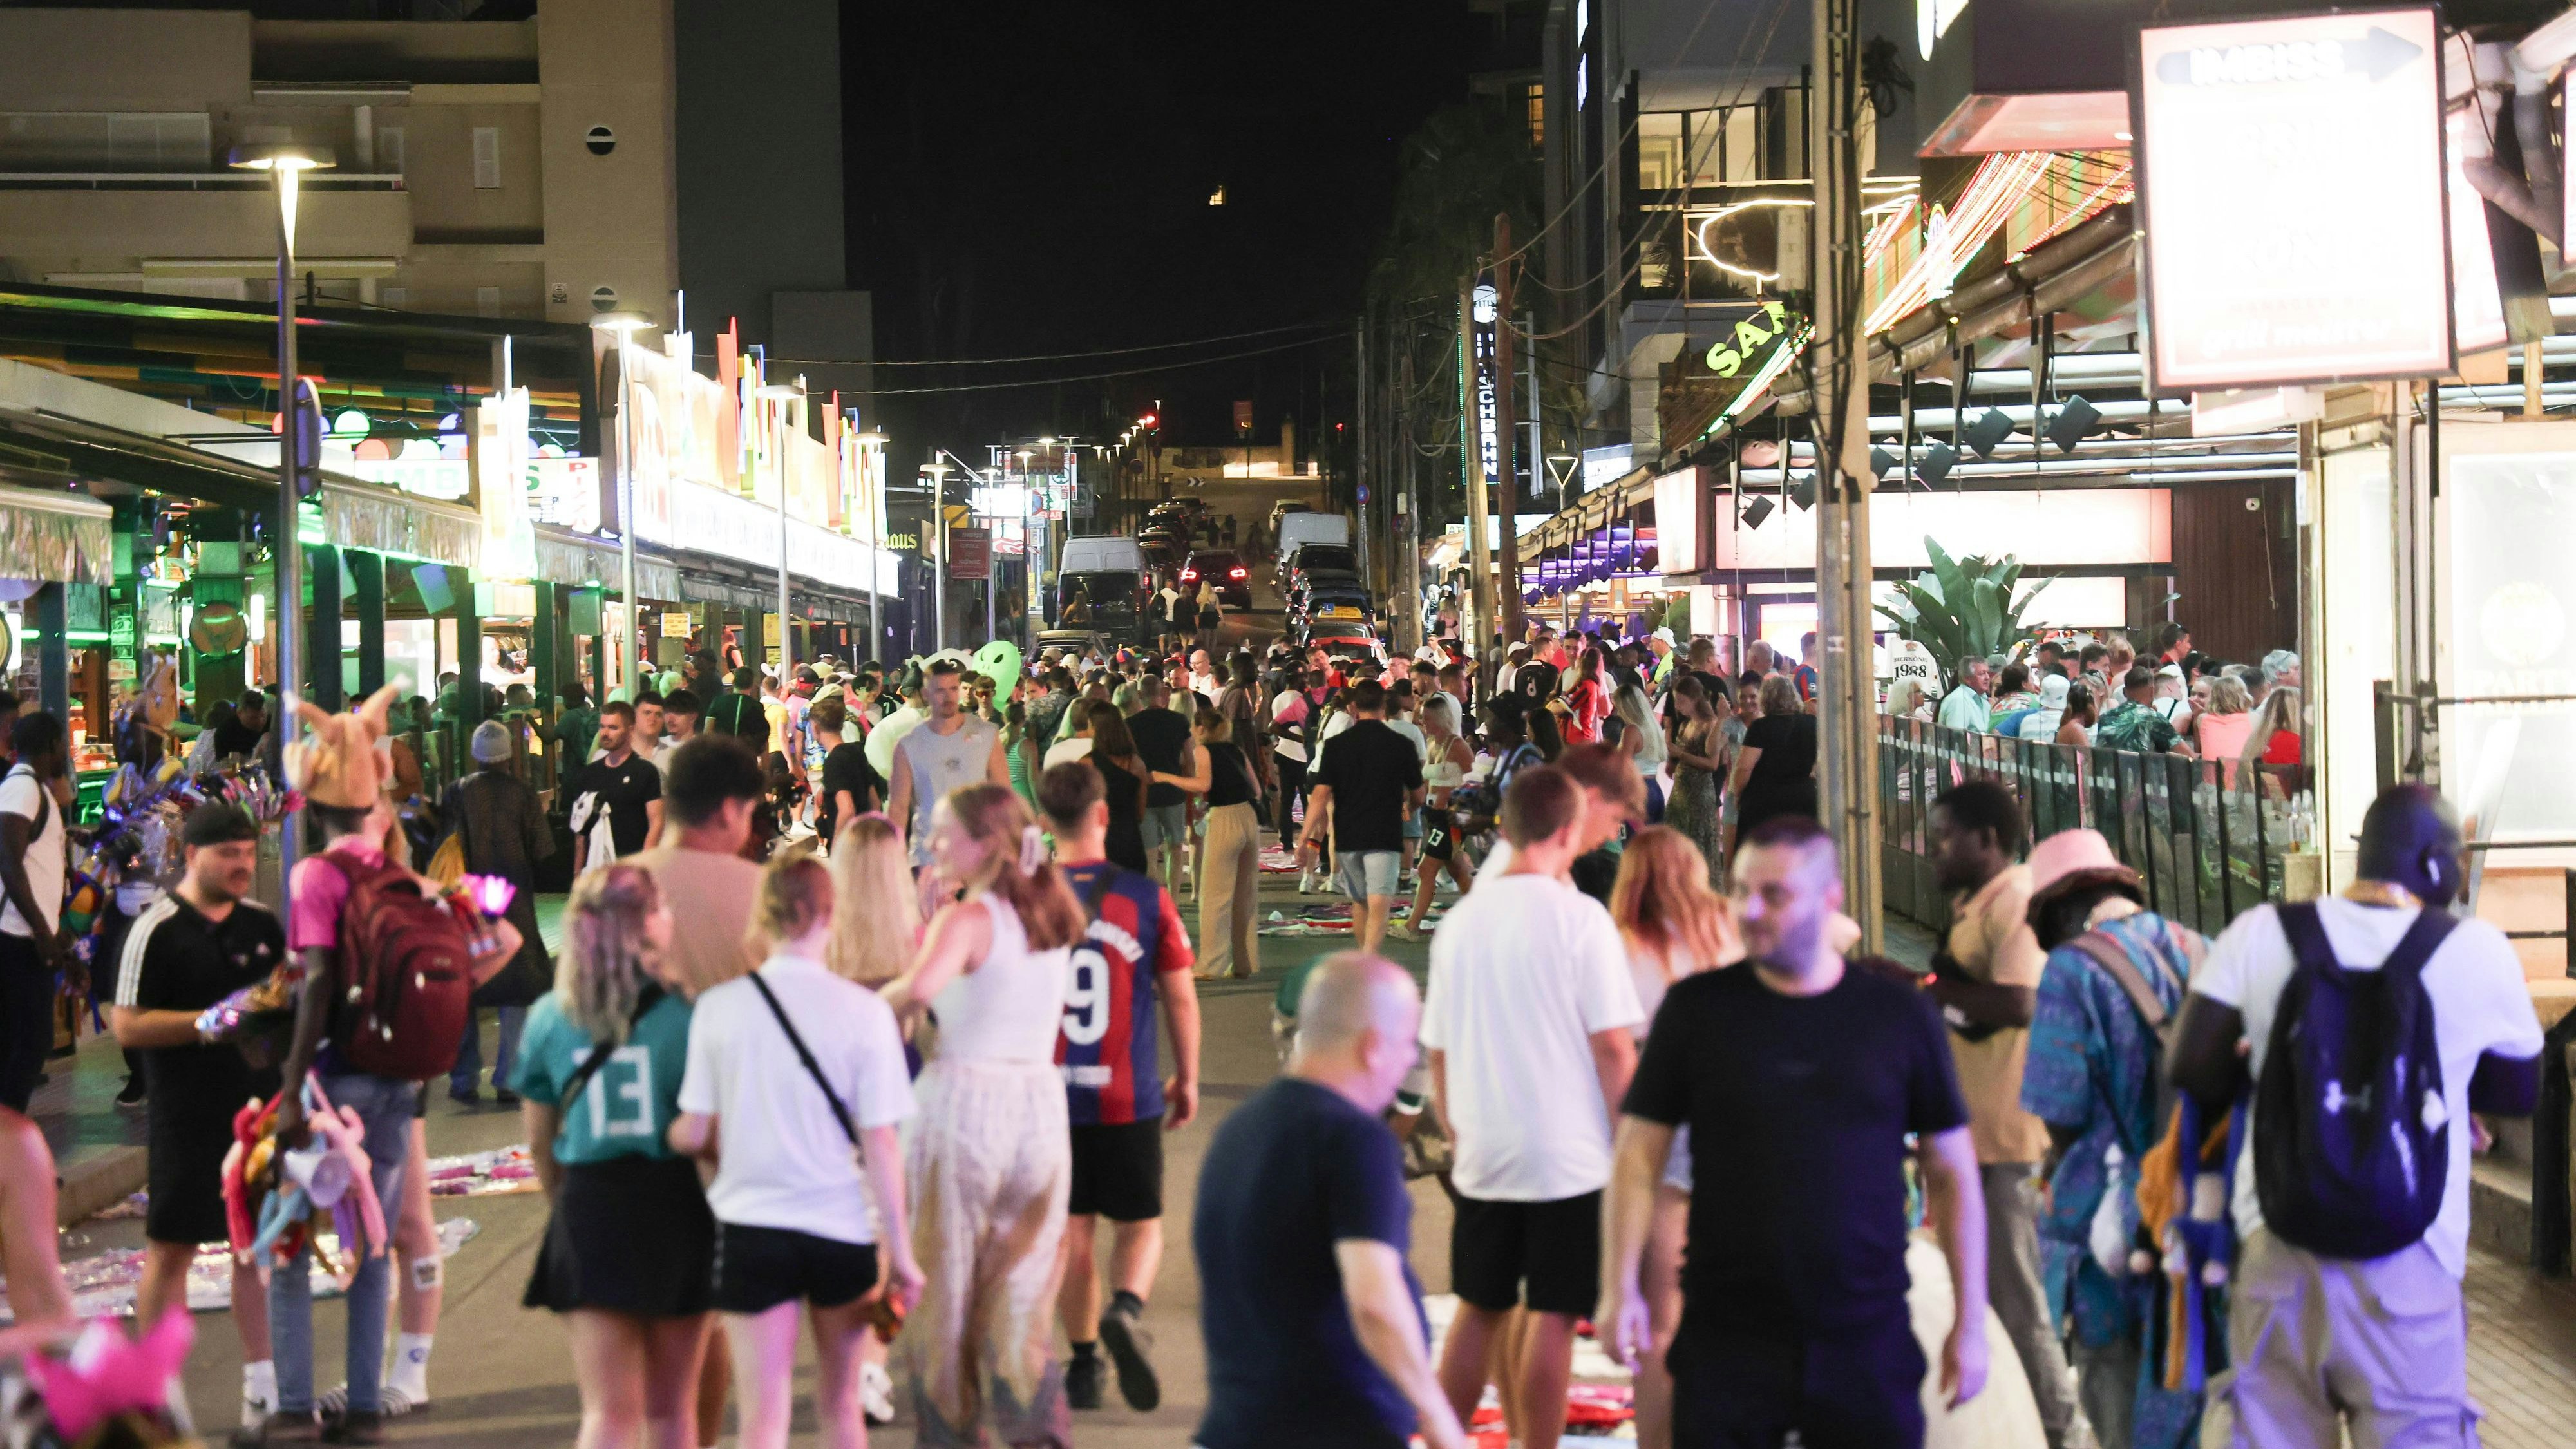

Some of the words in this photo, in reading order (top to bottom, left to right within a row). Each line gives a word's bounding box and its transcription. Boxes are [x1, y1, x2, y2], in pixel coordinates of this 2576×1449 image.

[2190, 40, 2345, 86] IMBISS
[1895, 664, 1927, 678] 1988
[883, 701, 890, 714] 7
[1428, 828, 1444, 846] 13
[1063, 947, 1110, 1045] 9
[572, 1046, 655, 1139] 13
